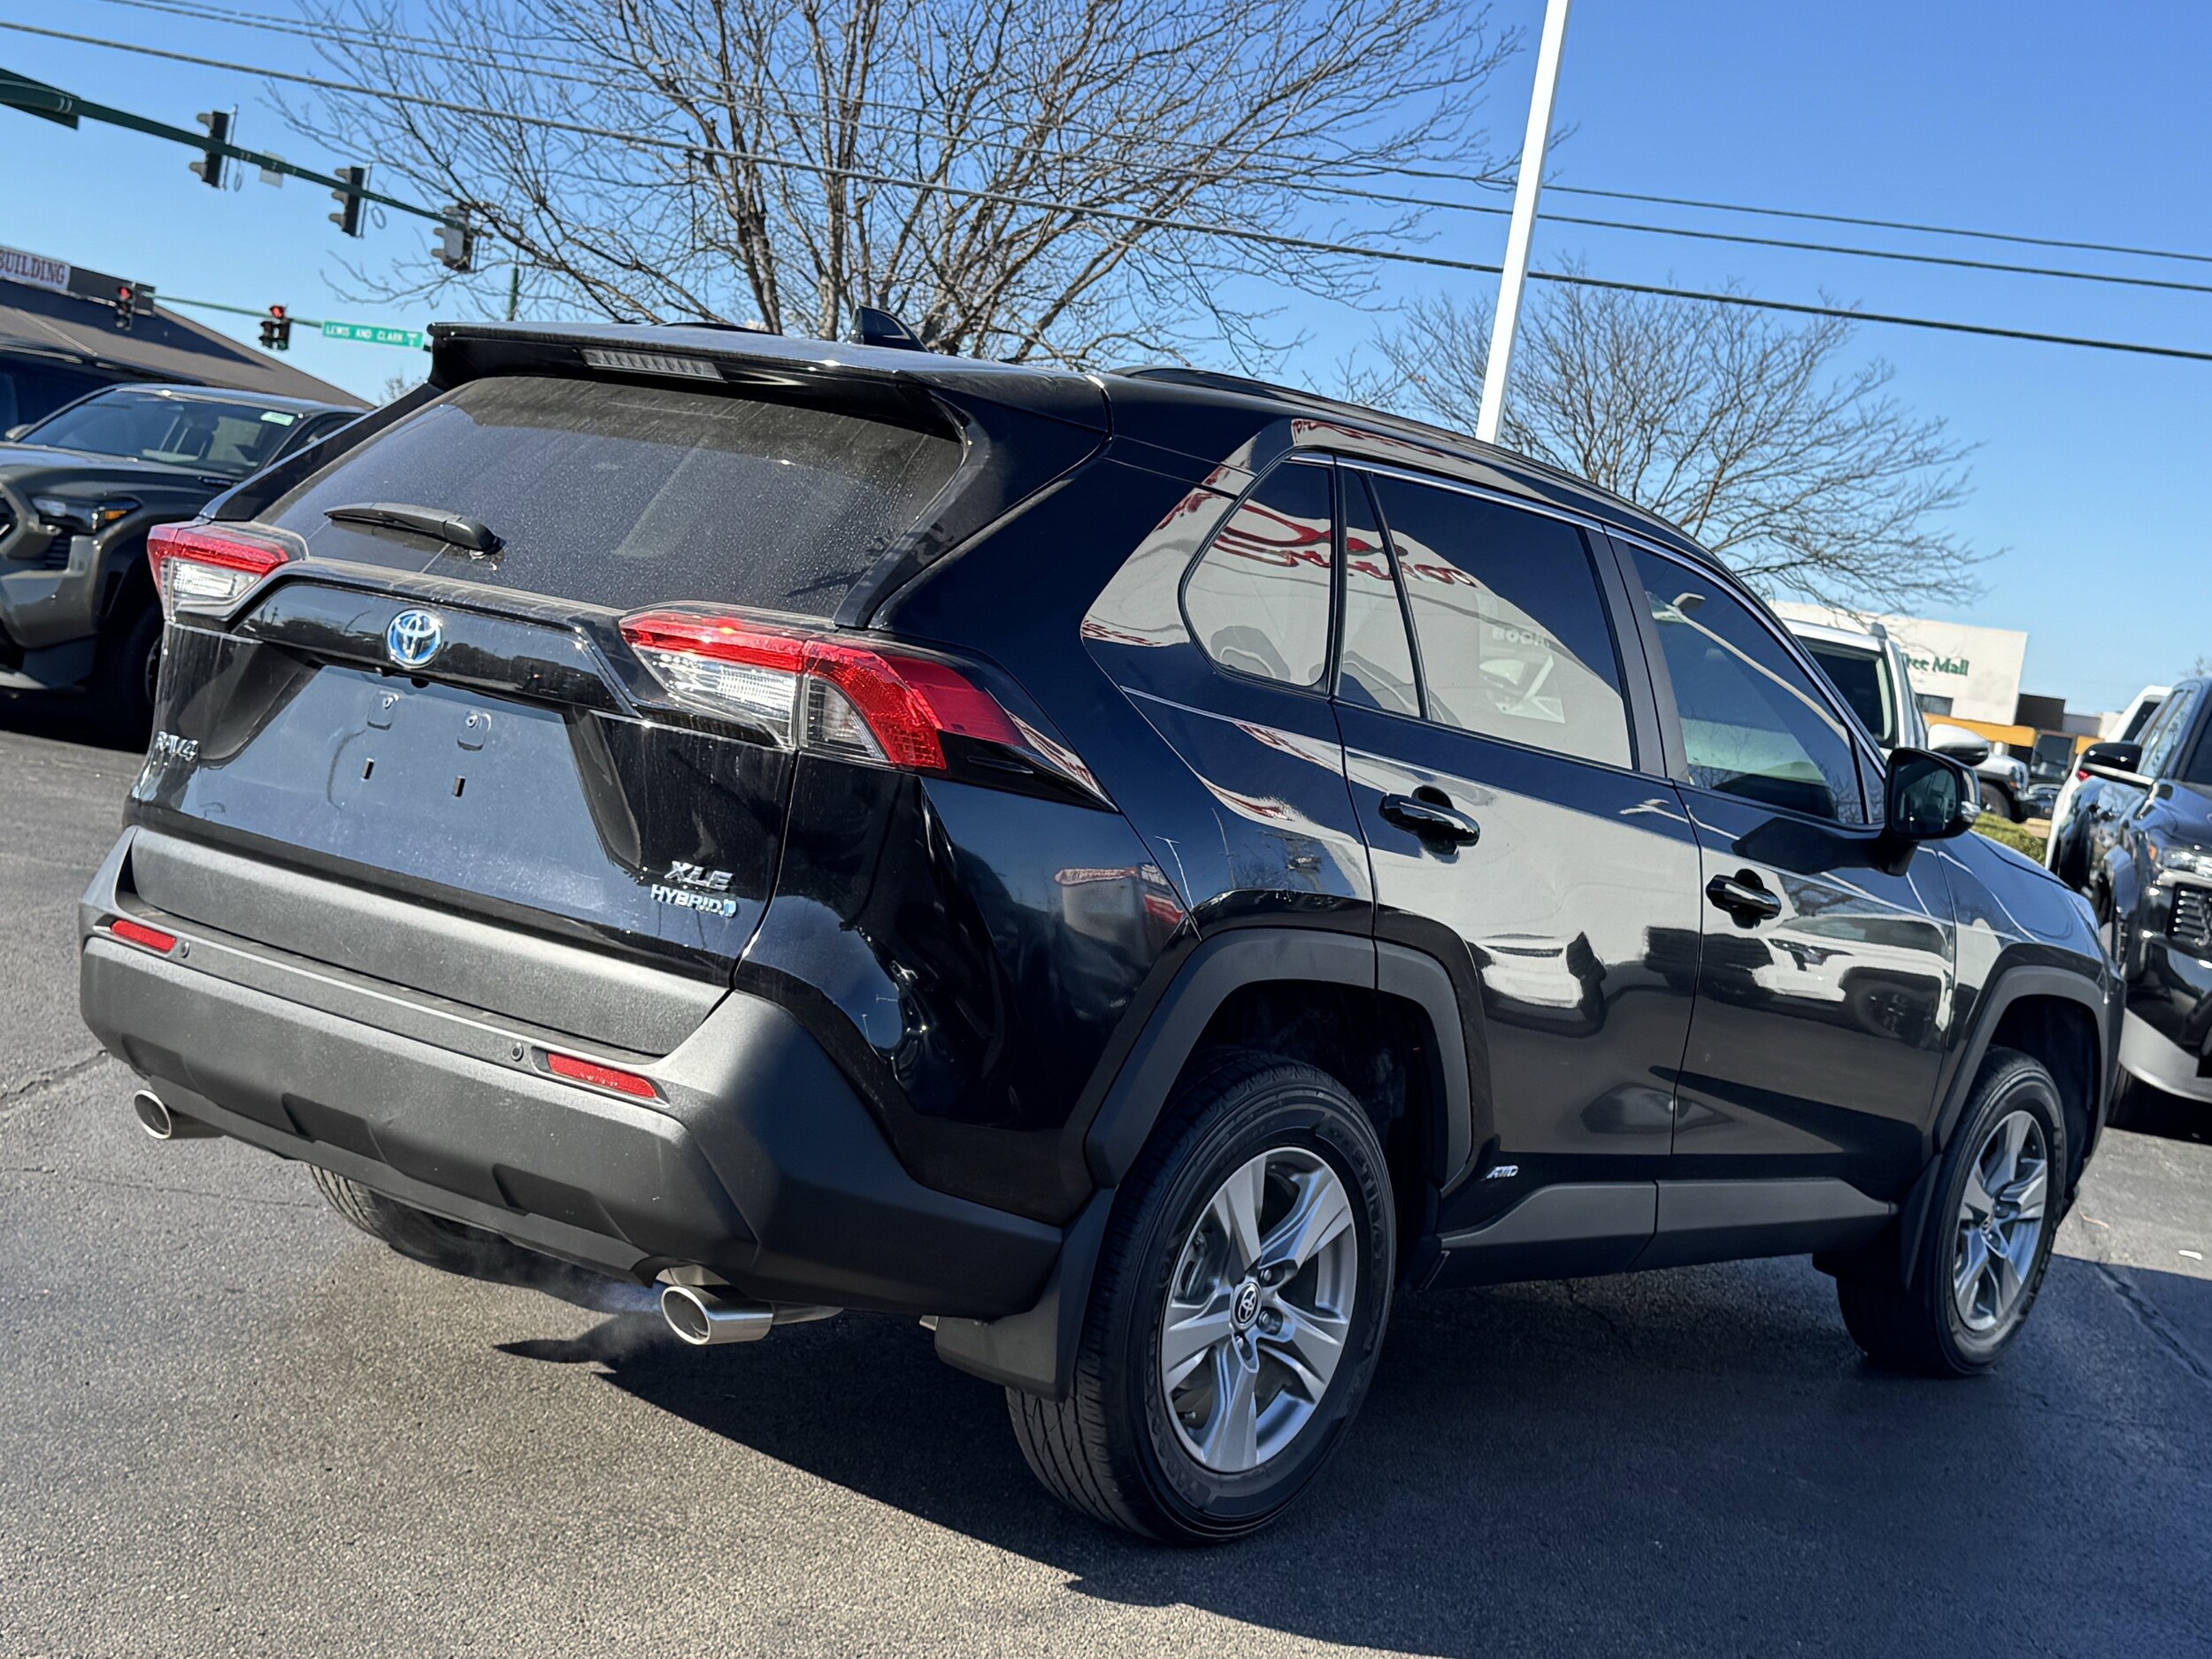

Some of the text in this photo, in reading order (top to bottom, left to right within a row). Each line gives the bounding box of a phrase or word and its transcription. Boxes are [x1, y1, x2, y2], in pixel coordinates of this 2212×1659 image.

[356, 327, 373, 339] AND
[376, 329, 403, 343] CLARK
[1932, 657, 1970, 676] Mall
[664, 860, 736, 892] XLE
[650, 884, 723, 913] HYBRID
